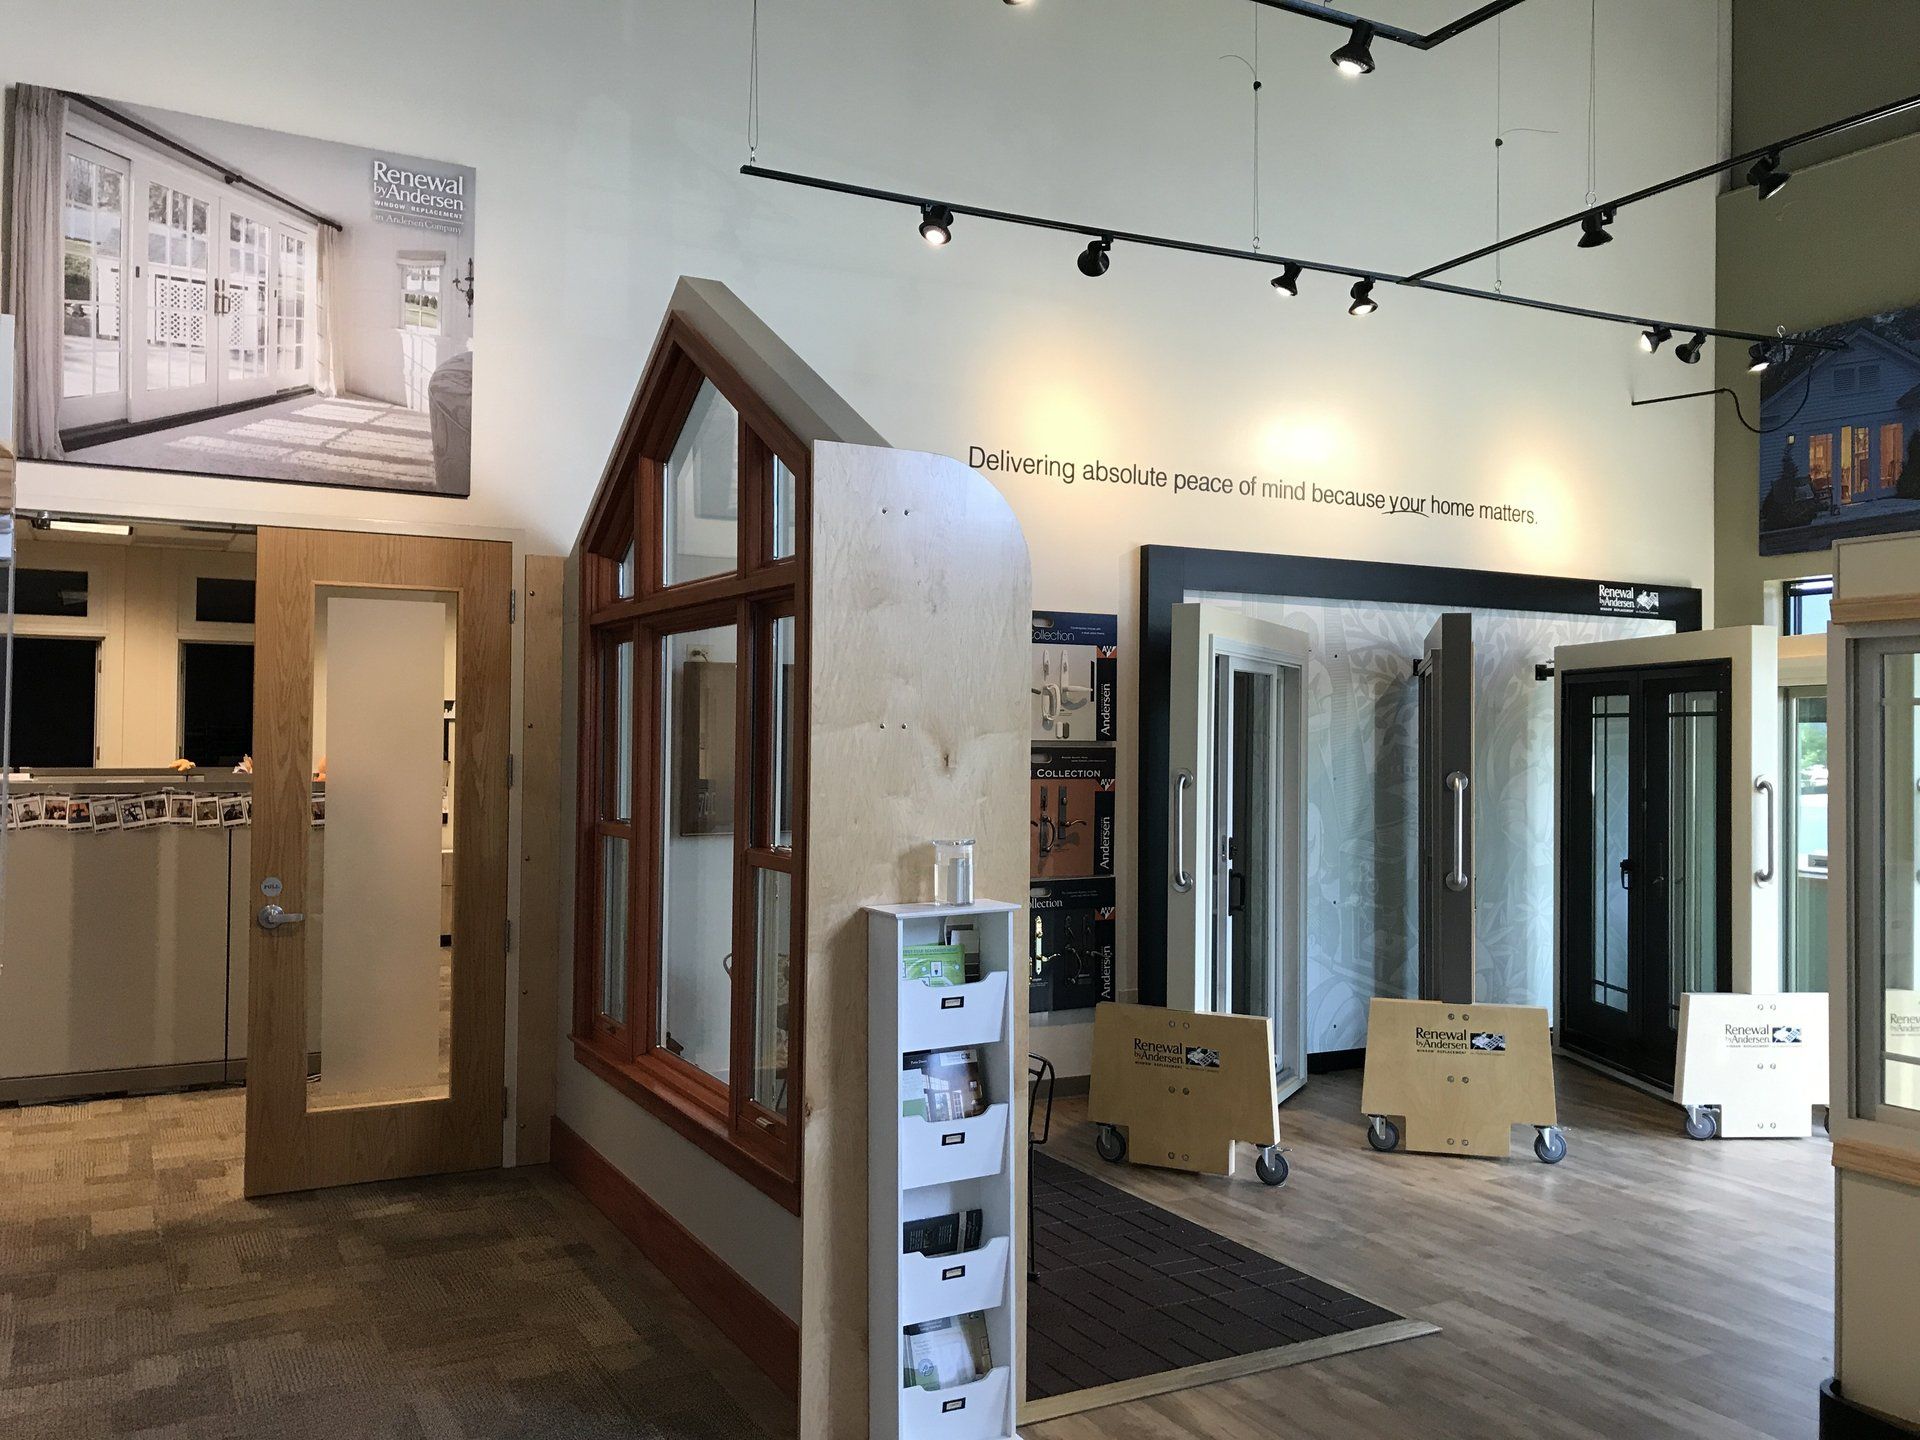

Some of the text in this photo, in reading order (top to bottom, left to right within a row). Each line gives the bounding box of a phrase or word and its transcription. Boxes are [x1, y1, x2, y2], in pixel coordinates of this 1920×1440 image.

[373, 160, 464, 196] Renewal
[373, 181, 464, 211] by Andersen
[374, 200, 463, 219] WINDOW REPLACEMENT
[425, 221, 462, 234] Company
[968, 445, 1539, 525] Delivering absolute peace of mind because your home matters.
[1598, 584, 1634, 599] Renewal
[1604, 597, 1635, 608] Andersen
[1100, 683, 1111, 736] Andersen
[1036, 768, 1101, 778] COLLECTION
[1100, 816, 1110, 870] Andersen
[1101, 945, 1111, 999] Andersen
[1415, 1027, 1467, 1041] Renewal
[1724, 1023, 1769, 1035] Renewal
[1134, 1038, 1183, 1055] Renewal
[1423, 1039, 1468, 1050] Andersen
[1731, 1035, 1770, 1044] Andersen
[1140, 1051, 1183, 1064] Andersen
